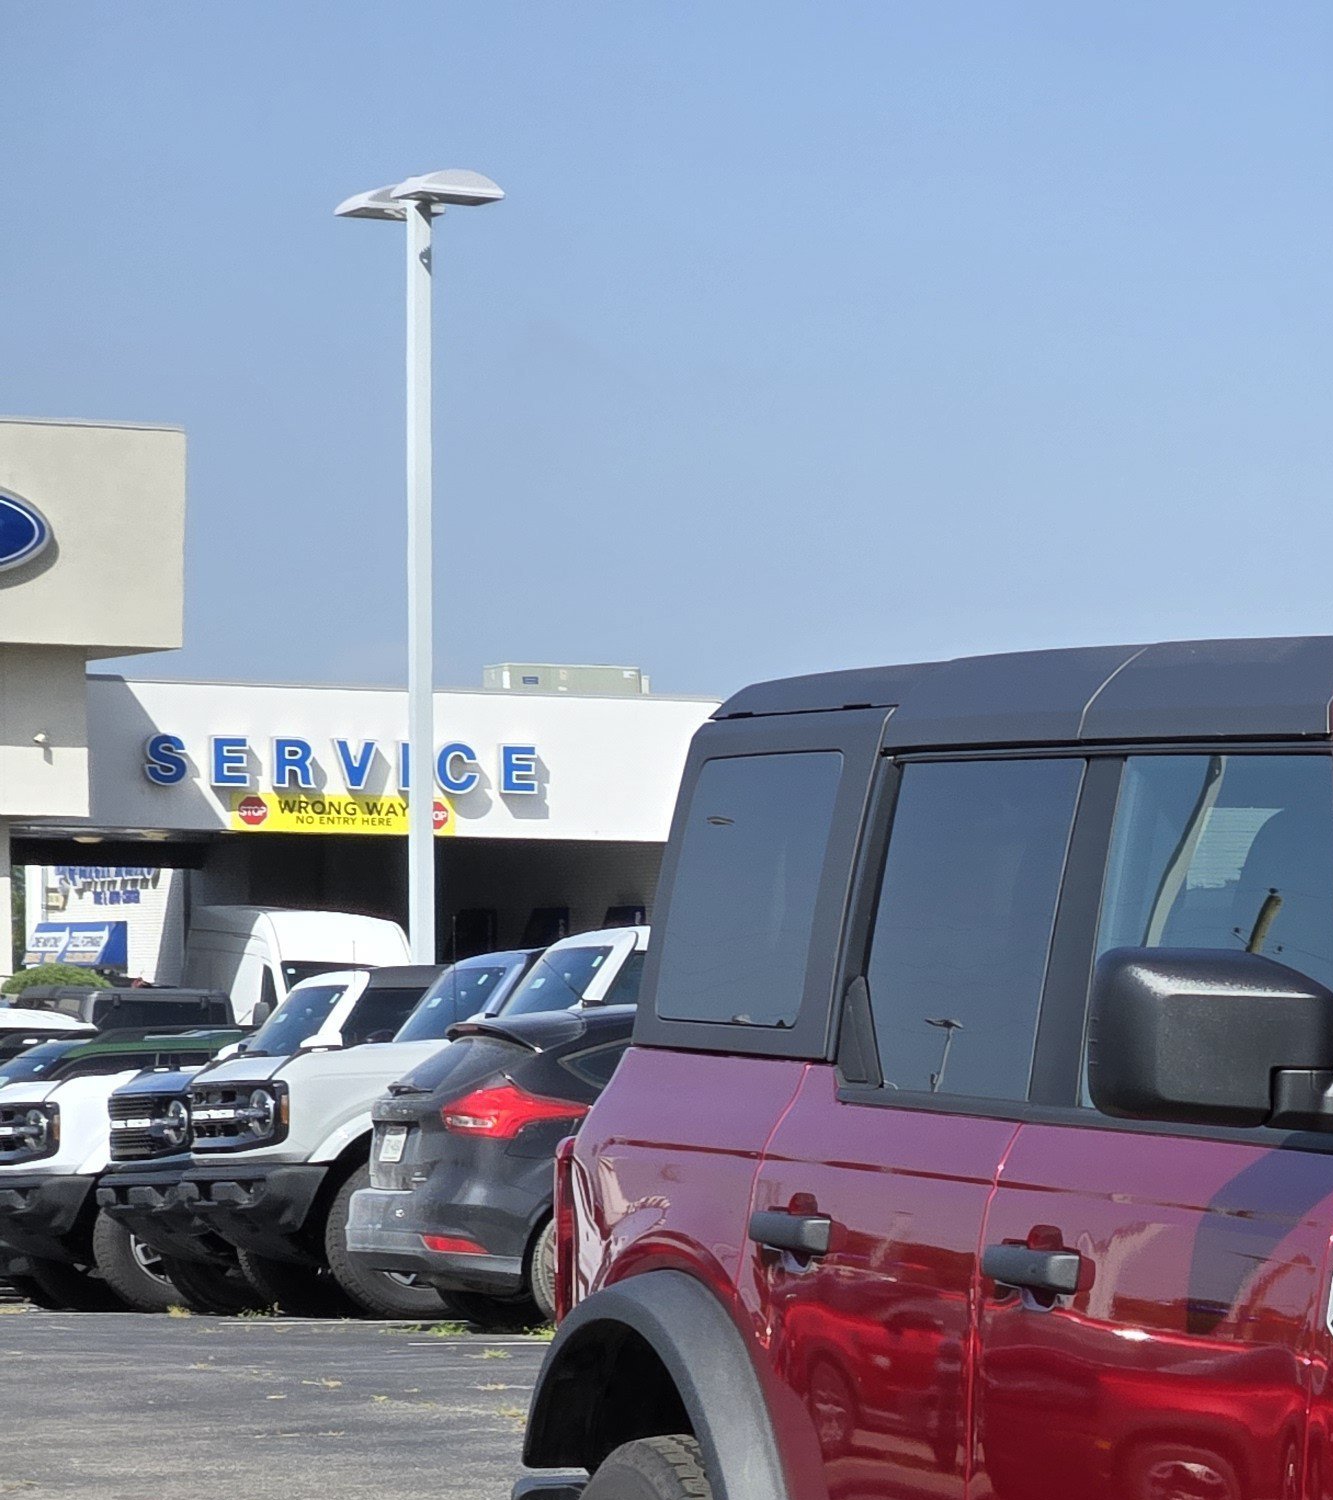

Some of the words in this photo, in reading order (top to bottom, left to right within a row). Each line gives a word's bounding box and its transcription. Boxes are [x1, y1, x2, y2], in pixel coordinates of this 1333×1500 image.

[144, 733, 538, 795] SERVICE
[238, 805, 268, 818] STOP
[278, 799, 357, 816] WRONG
[366, 801, 409, 818] WAY
[296, 814, 315, 825] NO
[318, 816, 356, 826] ENTRY
[361, 817, 392, 827] HERE
[433, 809, 448, 822] OP
